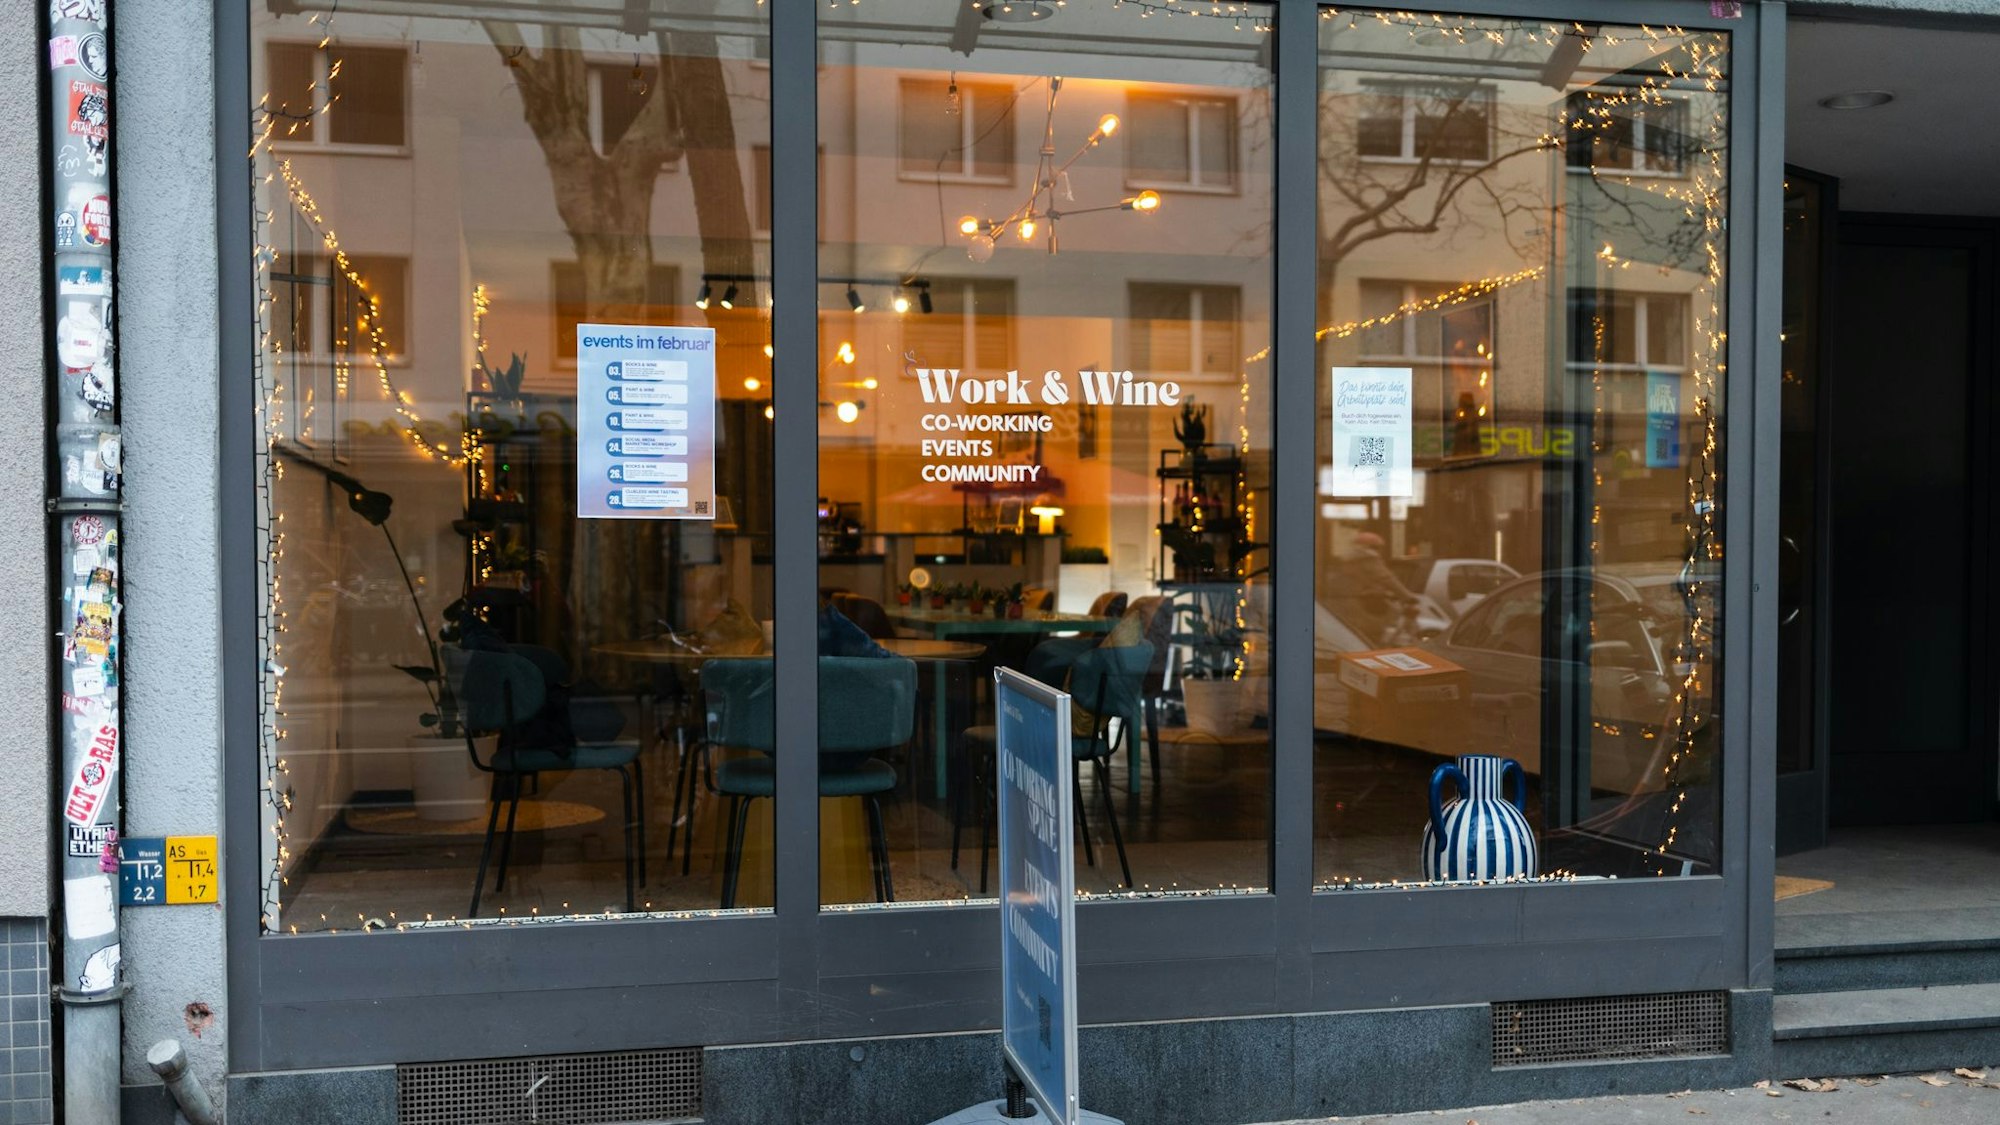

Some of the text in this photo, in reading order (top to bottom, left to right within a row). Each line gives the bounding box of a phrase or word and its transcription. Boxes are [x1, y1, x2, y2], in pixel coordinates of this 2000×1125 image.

[583, 334, 711, 351] events im februar
[608, 366, 621, 376] 03.
[916, 368, 1181, 406] Work & Wine
[608, 391, 621, 401] 05.
[609, 416, 620, 426] 10.
[921, 414, 1053, 432] CO-WORKING
[609, 443, 622, 452] 24.
[921, 440, 993, 457] EVENTS
[609, 469, 622, 479] 26.
[921, 465, 1041, 482] COMMUNITY
[1004, 749, 1056, 818] CO-WORKING
[1028, 799, 1057, 853] SPACE
[169, 846, 186, 858] AS
[133, 886, 155, 902] 2,2
[1024, 858, 1059, 920] EVENTS
[1009, 904, 1058, 985] COMMUNITY
